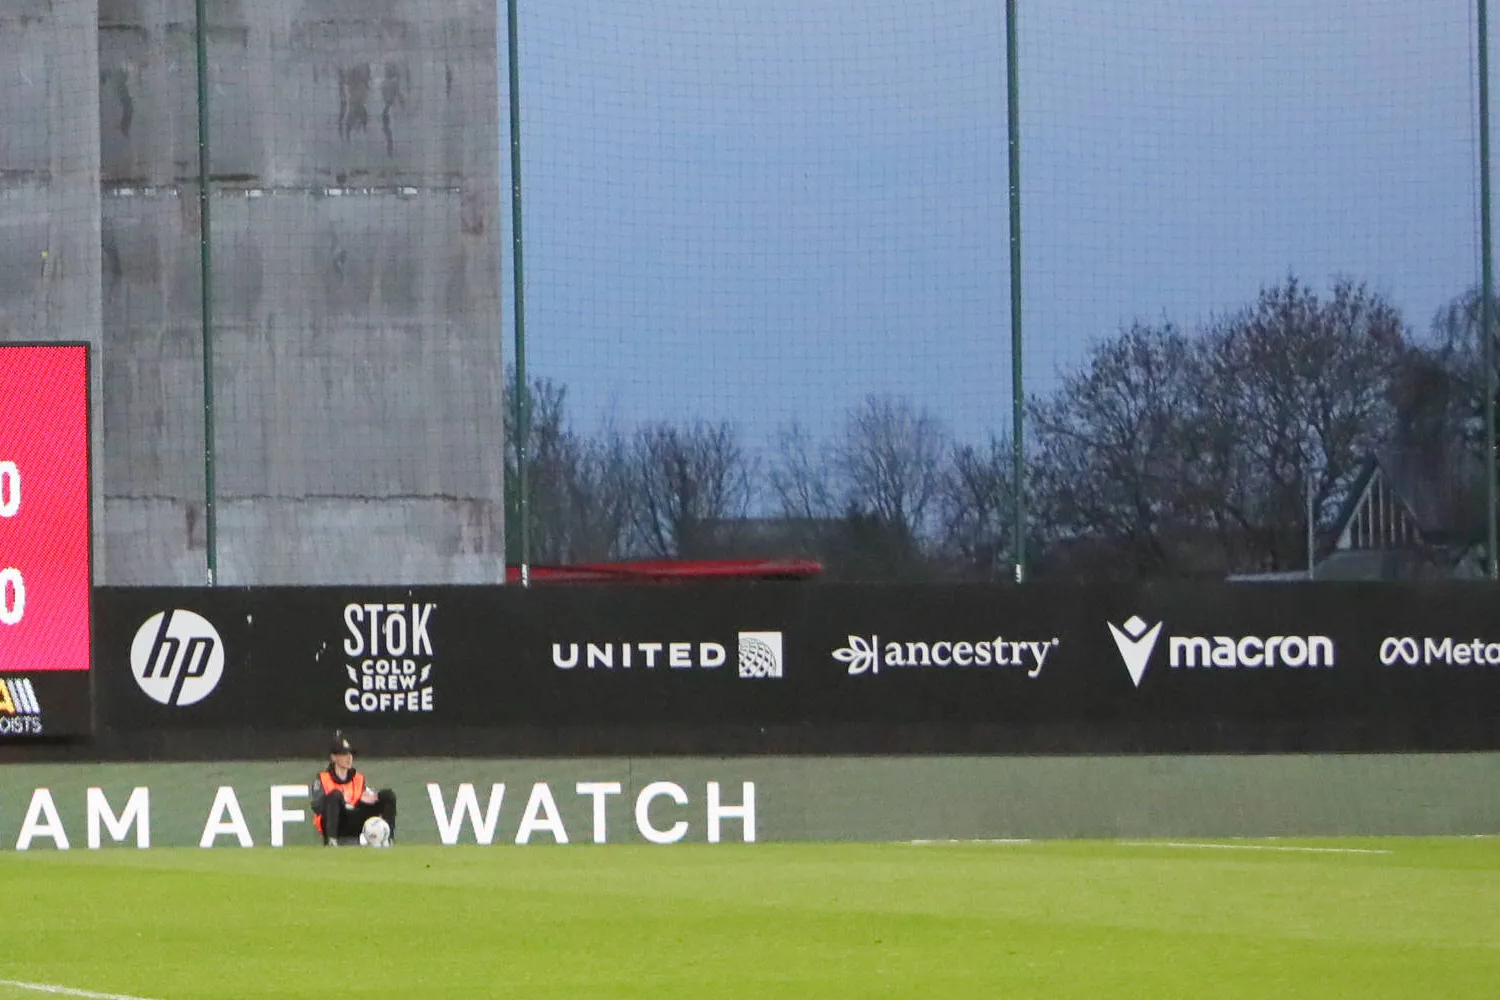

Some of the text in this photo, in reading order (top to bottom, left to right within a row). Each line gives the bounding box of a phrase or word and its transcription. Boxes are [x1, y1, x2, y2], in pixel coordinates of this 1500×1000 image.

[142, 609, 215, 705] hp
[552, 641, 727, 668] UNITED
[884, 635, 1051, 679] ancestry
[1169, 635, 1335, 667] macron
[362, 659, 416, 675] COLD
[362, 674, 418, 690] BREW
[344, 686, 434, 712] COFFEE
[200, 784, 309, 848] AF
[427, 781, 756, 846] WATCH
